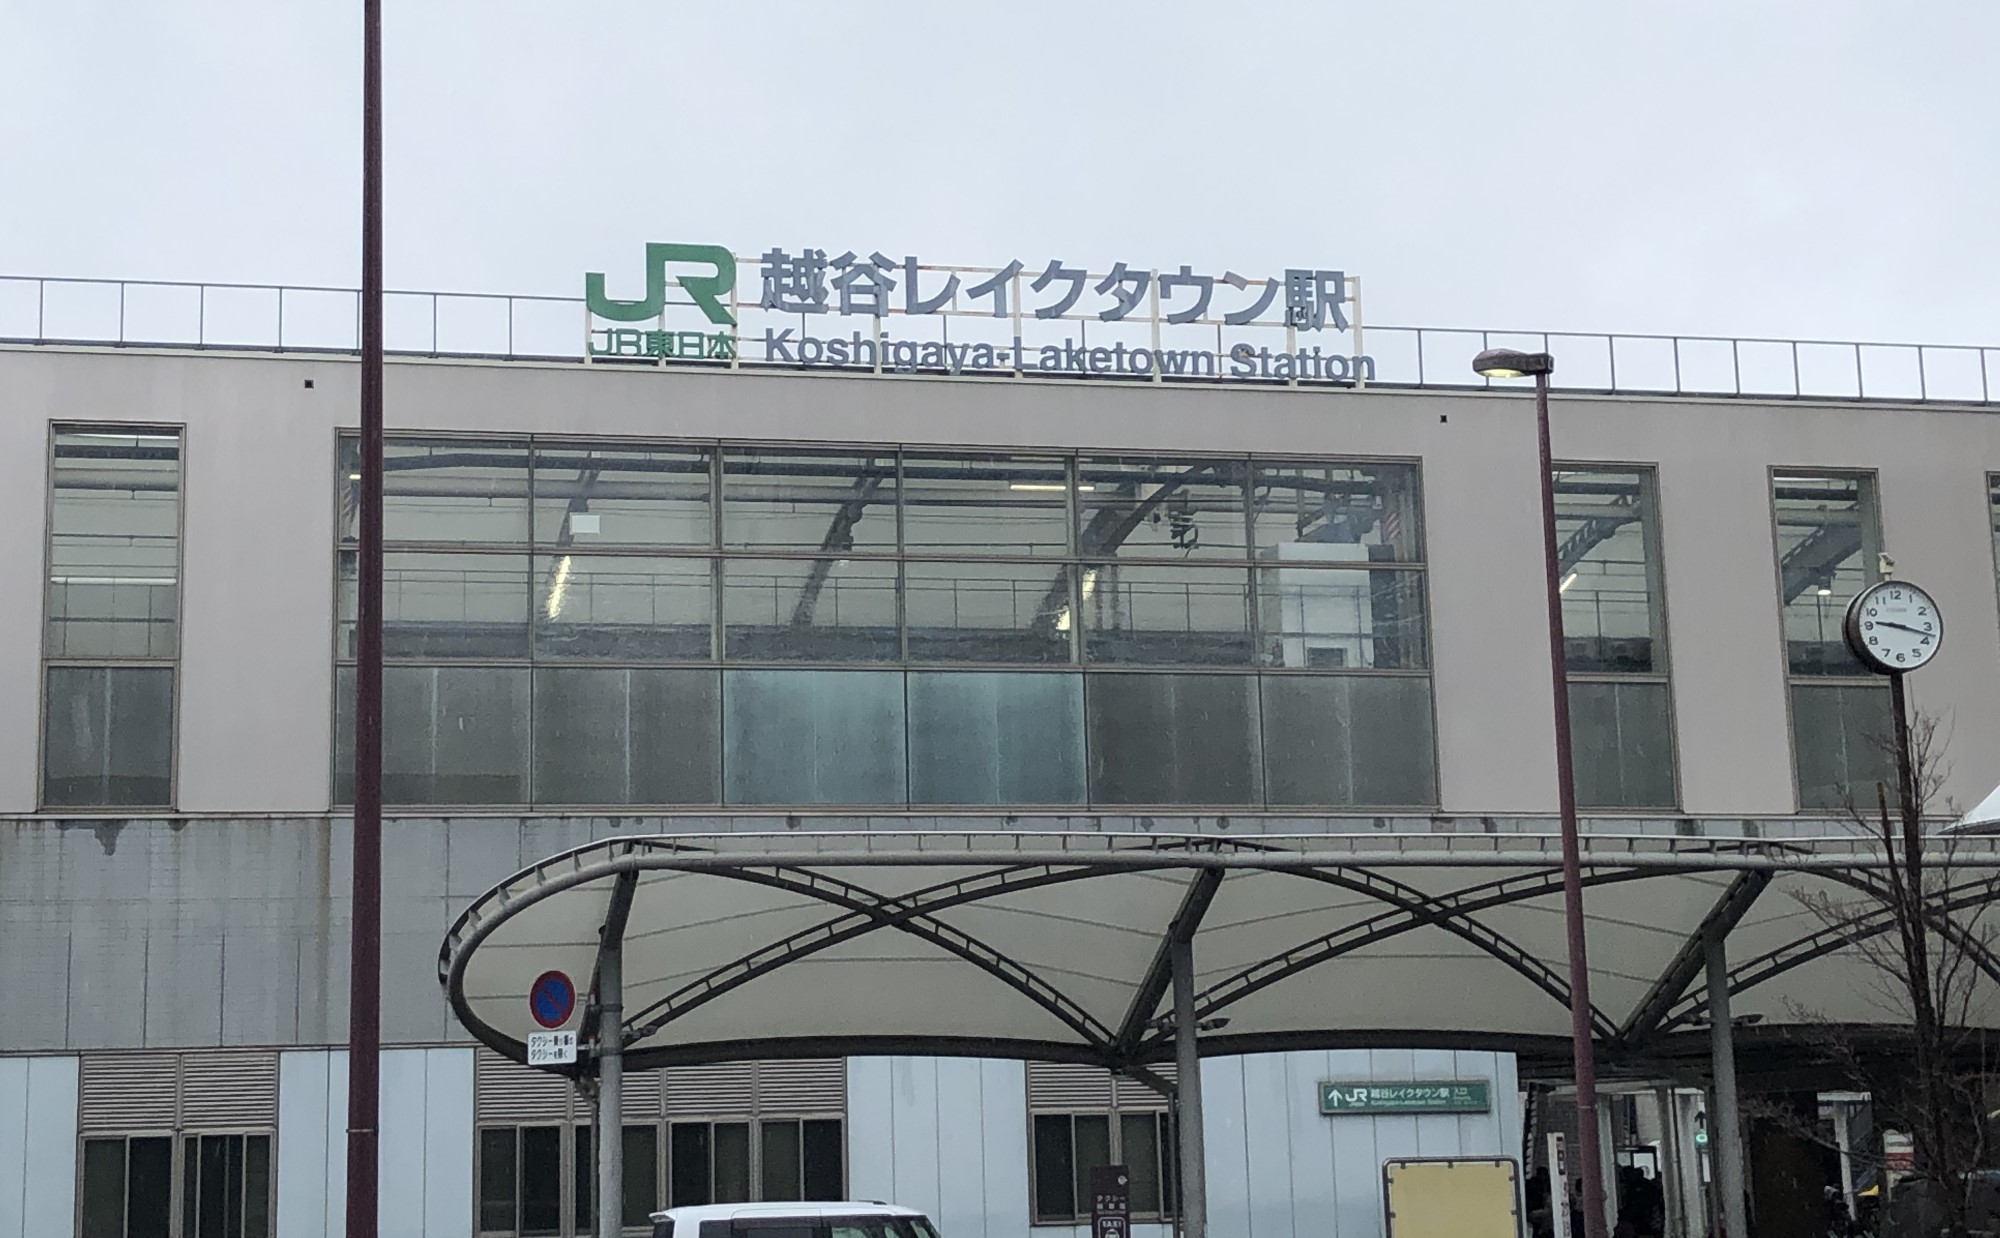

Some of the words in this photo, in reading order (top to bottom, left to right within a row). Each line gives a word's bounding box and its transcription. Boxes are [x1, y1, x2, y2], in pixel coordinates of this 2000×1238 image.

[585, 242, 737, 326] JR
[760, 247, 1349, 333] 越谷レイクタウン駅
[588, 327, 737, 359] JR東日本
[765, 327, 1214, 377] Koshigaya-Laketown
[1230, 343, 1376, 383] Station
[1889, 590, 1902, 599] 12
[1875, 596, 1886, 605] 11
[1866, 608, 1878, 617] 10
[1918, 606, 1927, 615] 2
[1864, 621, 1874, 631] 9
[1923, 622, 1932, 631] 3
[1869, 636, 1879, 645] 8
[1920, 636, 1930, 645] 4
[1881, 648, 1891, 658] 7
[1896, 653, 1906, 663] 6
[1911, 648, 1922, 658] 5
[531, 1035, 574, 1047] タクシー
[531, 1048, 568, 1060] タクシーをく
[1345, 1089, 1367, 1102] JR
